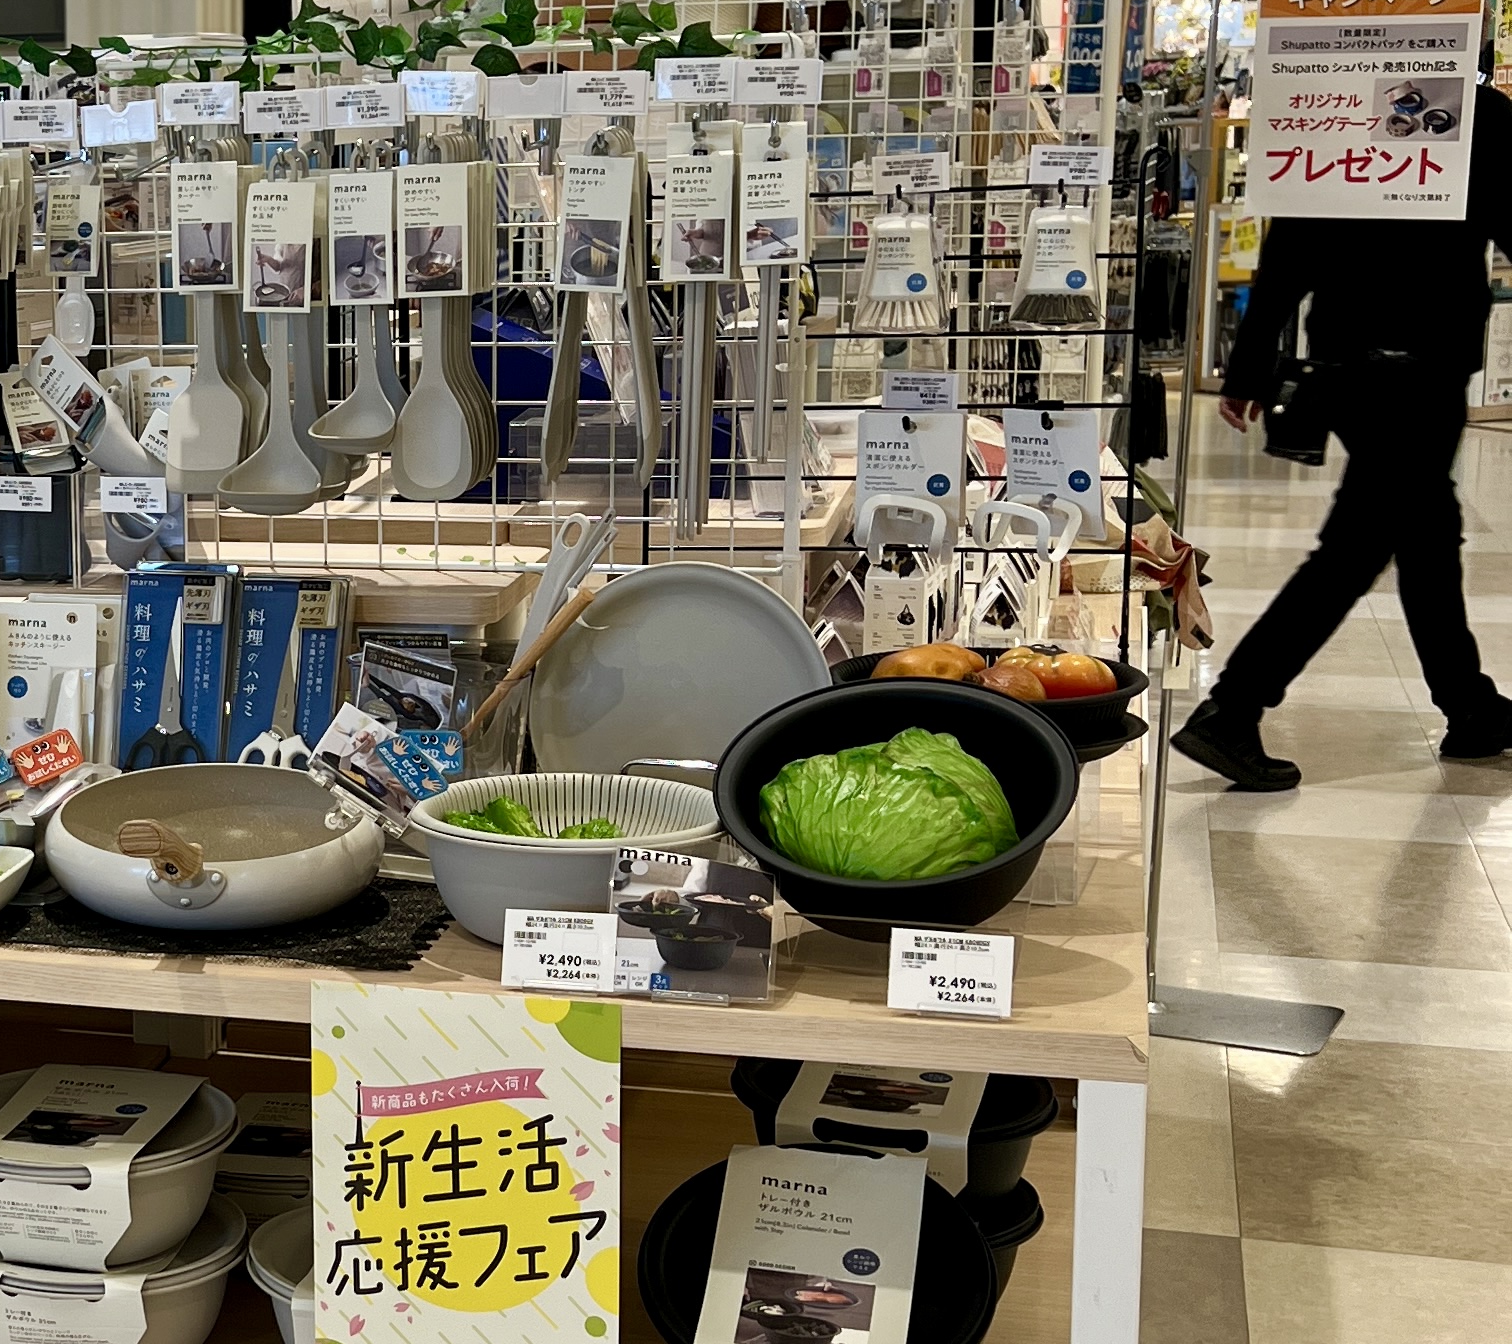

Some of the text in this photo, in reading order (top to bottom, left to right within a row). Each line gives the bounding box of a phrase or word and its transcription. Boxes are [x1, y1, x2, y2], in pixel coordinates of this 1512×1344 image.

[1281, 40, 1331, 51] Shupatto
[1333, 39, 1404, 50] コンパクトバッグ
[1272, 59, 1458, 75] Shupatto シュパット 発売10th記念
[1288, 94, 1363, 109] オリジナル
[1267, 116, 1382, 133] マスキングテープ
[569, 166, 606, 176] marna
[672, 166, 713, 175] marna
[1265, 146, 1444, 185] プレゼント
[177, 173, 212, 182] marna
[403, 176, 441, 185] marna
[747, 172, 782, 181] marna
[334, 184, 367, 194] marna
[252, 194, 289, 202] marna
[1037, 227, 1071, 235] marna
[866, 439, 910, 450] marna
[1011, 435, 1049, 446] marna
[865, 463, 925, 471] スポンジホルダー
[1012, 457, 1065, 465] スポンジホルダー
[244, 585, 274, 593] marna
[8, 618, 48, 628] marna
[131, 602, 153, 714] 料理のハサミ
[243, 608, 266, 718] 料理のハサミ
[619, 847, 693, 867] marna
[538, 953, 582, 967] ¥2,490
[546, 968, 581, 980] ¥2,264
[929, 975, 976, 990] ¥2,490
[937, 990, 975, 1003] ¥2,264
[58, 1078, 116, 1090] marna
[370, 1074, 531, 1111] 新商品もたくさん入荷!
[343, 1114, 569, 1212] 新生活
[761, 1175, 828, 1196] marna
[760, 1192, 811, 1208] トレー付き
[758, 1203, 853, 1224] ザルボウル 21cm
[326, 1209, 608, 1297] 応援フェア
